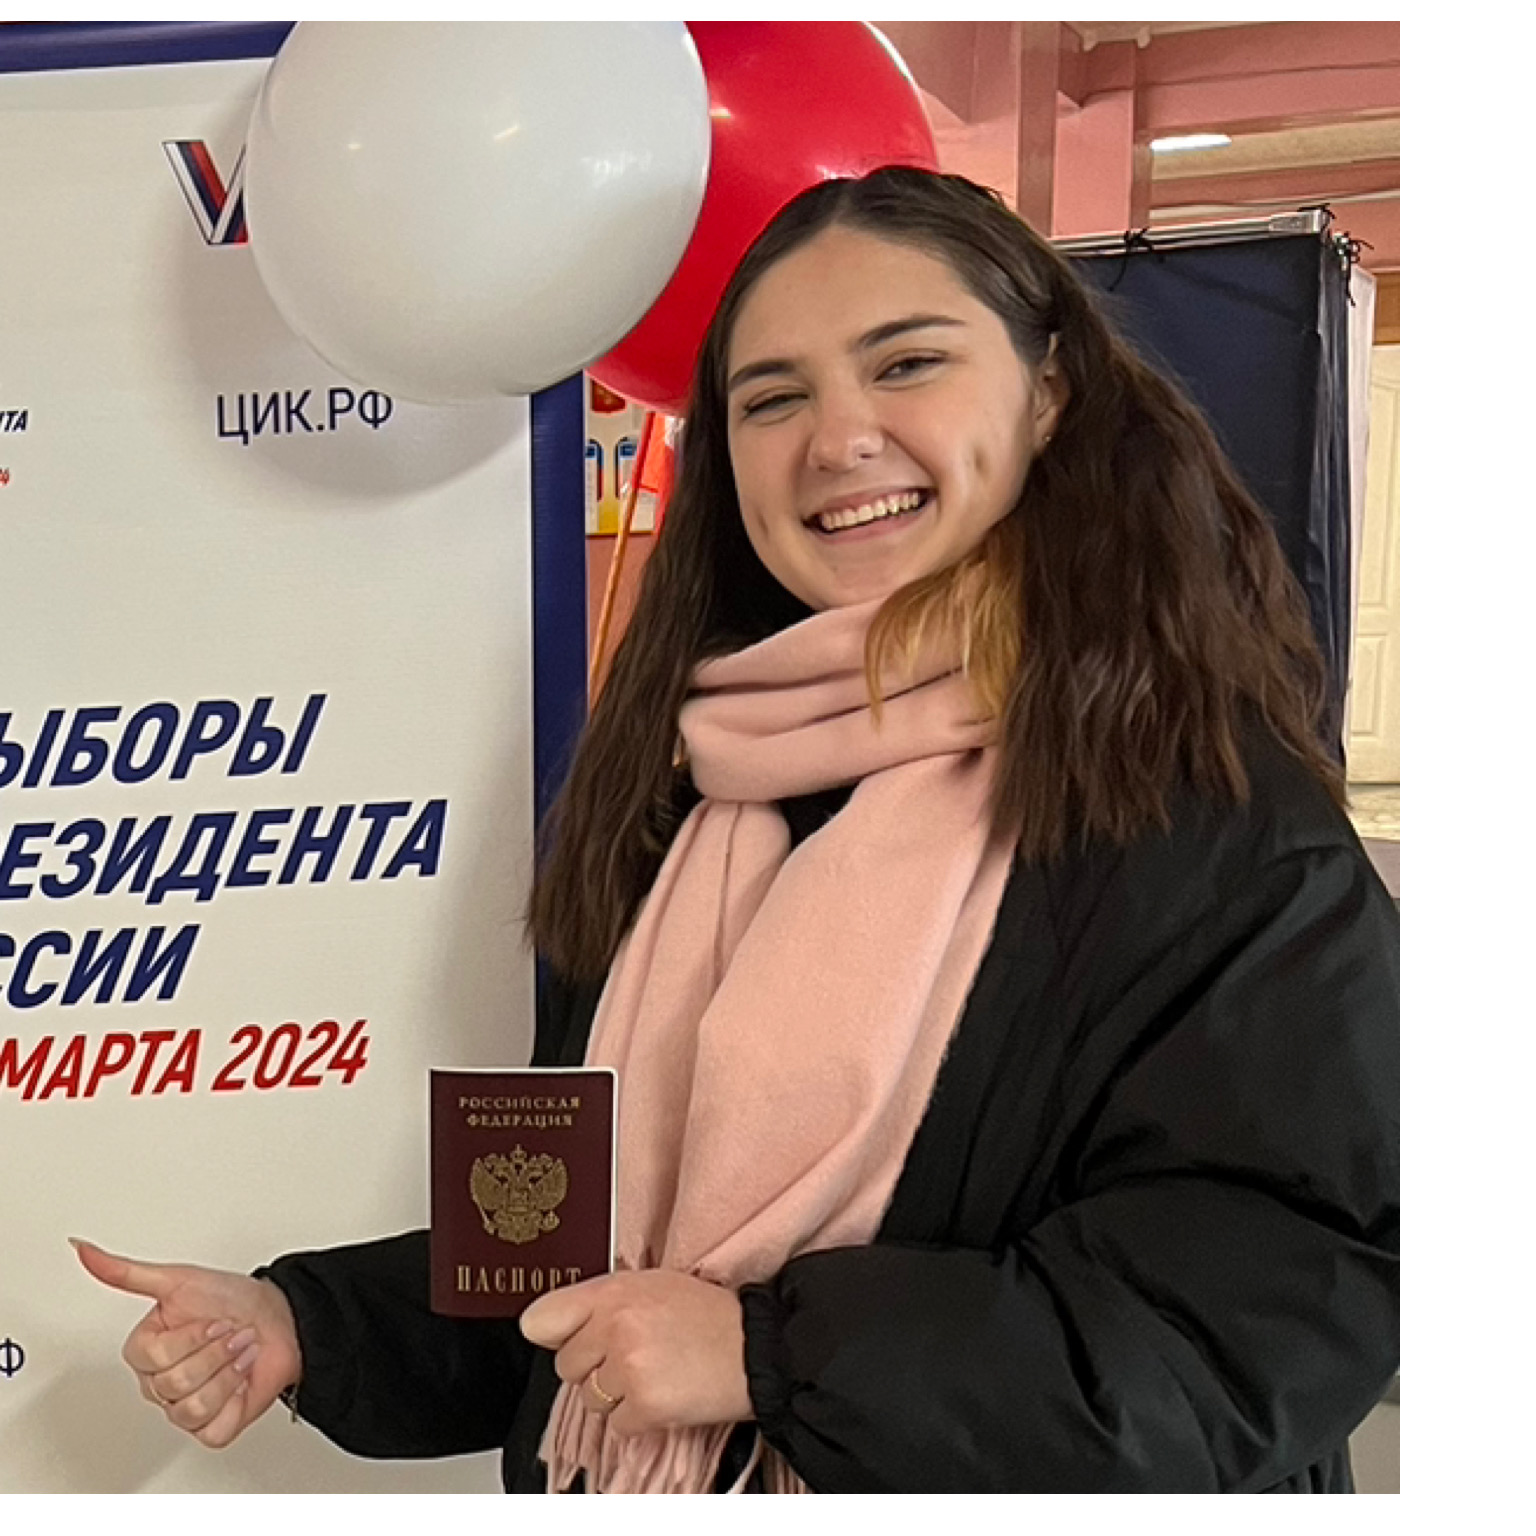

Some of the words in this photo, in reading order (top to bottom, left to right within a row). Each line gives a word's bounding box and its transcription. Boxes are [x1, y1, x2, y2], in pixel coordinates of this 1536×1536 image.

[217, 387, 393, 446] ЦИК.РФ
[212, 1019, 369, 1091] 2024
[458, 1096, 580, 1109] РОССИЙСКАЯ
[466, 1114, 573, 1128] ФЕДЕРАЦИЯ
[457, 1266, 582, 1292] ПАСПОРТ
